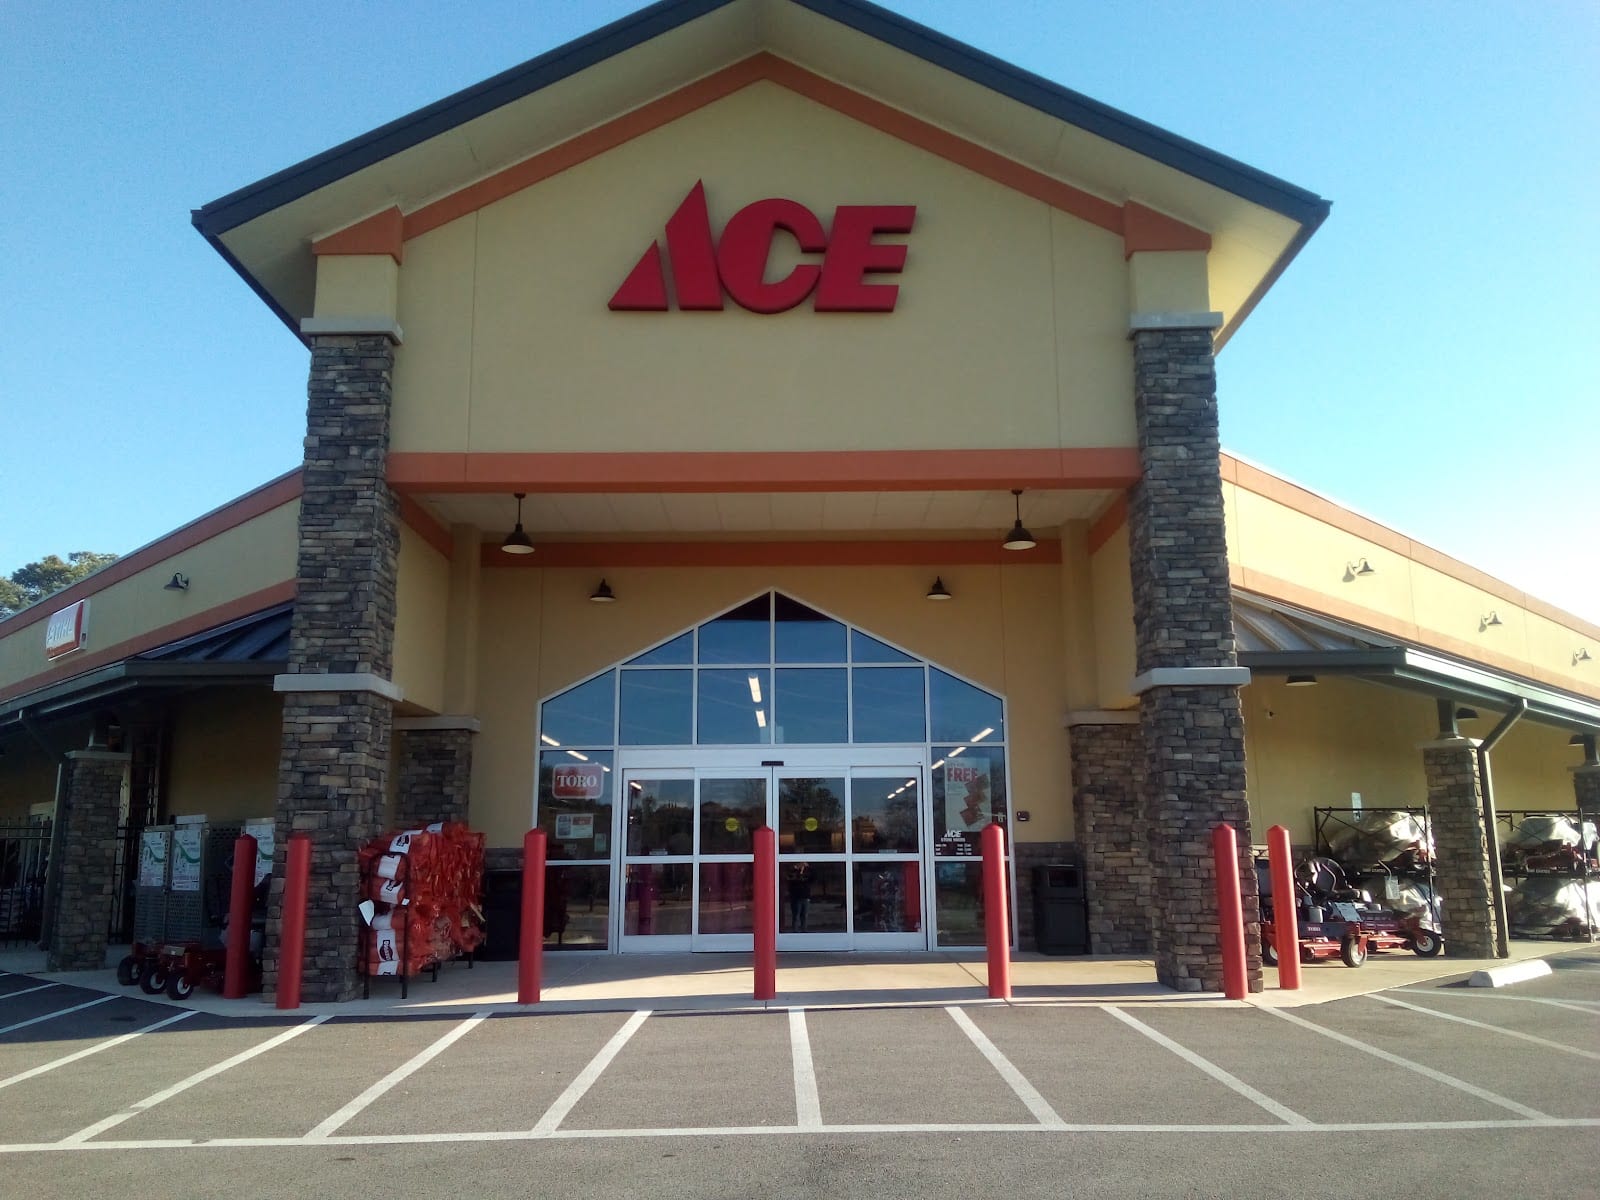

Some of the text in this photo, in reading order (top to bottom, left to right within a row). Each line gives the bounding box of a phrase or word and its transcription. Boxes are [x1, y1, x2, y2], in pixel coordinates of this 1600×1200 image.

[608, 178, 917, 315] ACE
[556, 775, 597, 788] TORO
[947, 767, 979, 782] FREE
[943, 829, 962, 838] ACE
